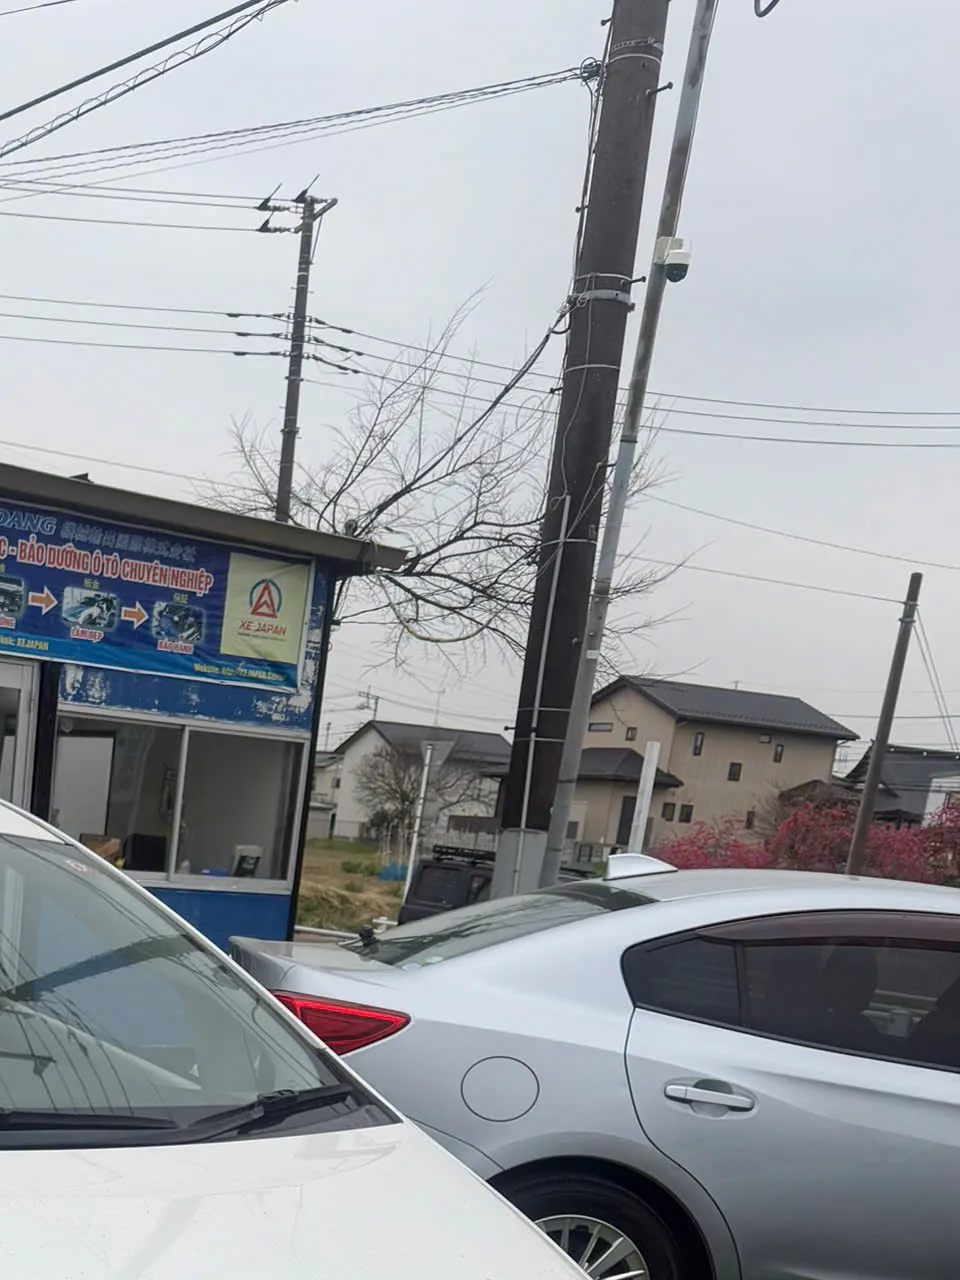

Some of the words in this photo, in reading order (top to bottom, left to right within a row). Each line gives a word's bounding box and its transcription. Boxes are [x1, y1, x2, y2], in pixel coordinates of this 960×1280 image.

[17, 534, 46, 565] BẢO
[47, 543, 90, 573] DƯỠNG
[92, 550, 102, 575] Ô
[104, 553, 121, 578] TÔ
[121, 560, 169, 587] CHUYÊN
[169, 567, 214, 597] NGHIỆP
[239, 620, 253, 631] XE
[254, 623, 287, 636] JAPAN
